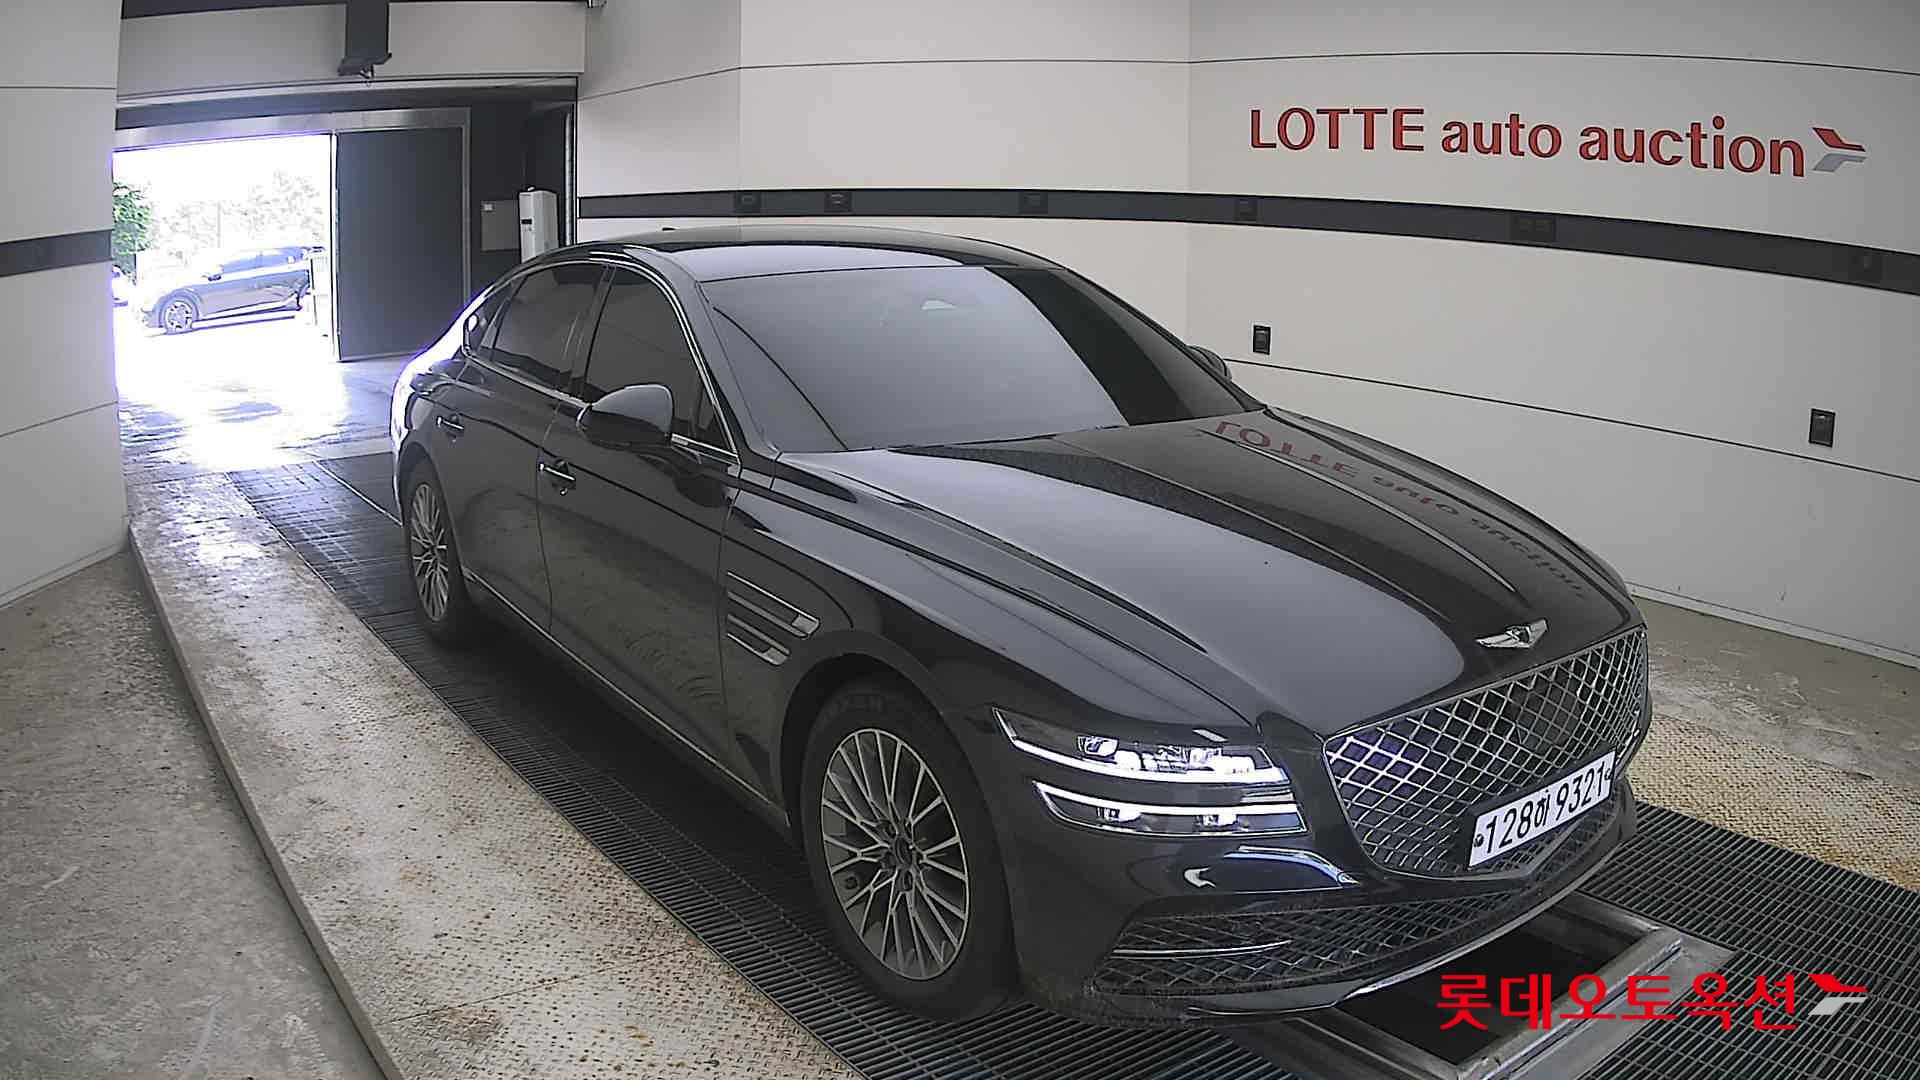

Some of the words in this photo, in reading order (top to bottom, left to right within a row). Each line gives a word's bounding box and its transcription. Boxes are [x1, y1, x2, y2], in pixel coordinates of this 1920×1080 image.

[1250, 107, 1425, 152] LOTTE
[1441, 113, 1563, 158] auto
[1578, 115, 1806, 178] auction
[1556, 761, 1605, 821] 9321
